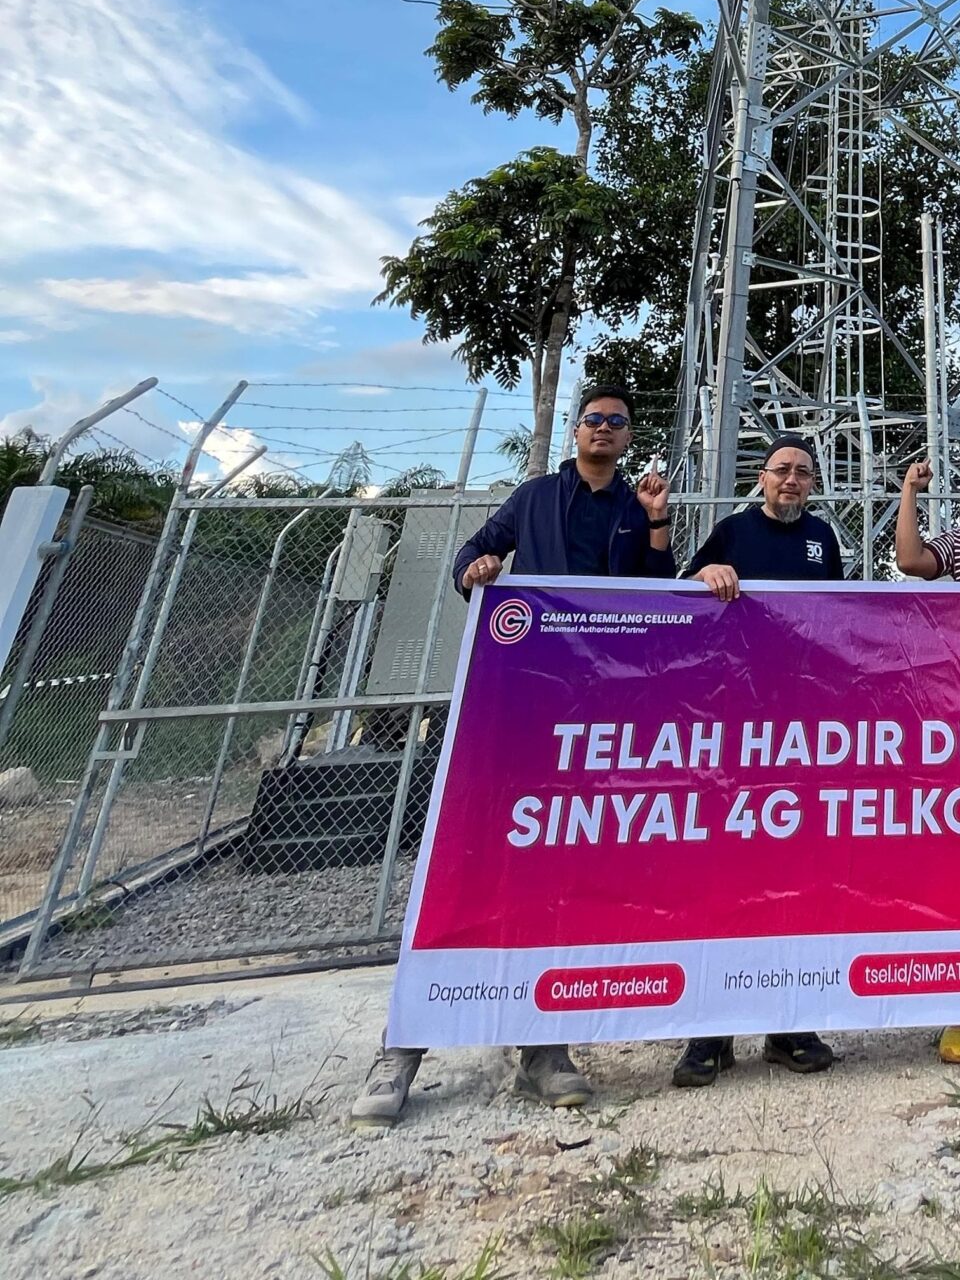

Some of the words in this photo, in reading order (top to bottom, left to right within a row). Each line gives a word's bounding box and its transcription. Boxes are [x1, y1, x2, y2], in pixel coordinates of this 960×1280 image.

[806, 544, 823, 557] 30
[540, 613, 587, 624] CAHAYA
[588, 613, 643, 624] GEMILANG
[644, 614, 693, 625] CELLULAR
[540, 625, 578, 633] Telkomsel
[578, 625, 620, 634] Authorized
[620, 626, 648, 634] Partner
[553, 721, 723, 772] TELAH
[738, 720, 905, 767] HADIR
[505, 791, 710, 848] SINYAL
[724, 788, 802, 840] 4G
[551, 980, 598, 999] Outlet
[602, 976, 669, 997] Terdekat
[724, 971, 753, 991] Info
[757, 968, 794, 989] lebih
[799, 968, 841, 992] lanjut
[428, 981, 509, 1007] Dapatkan
[513, 980, 529, 1001] di
